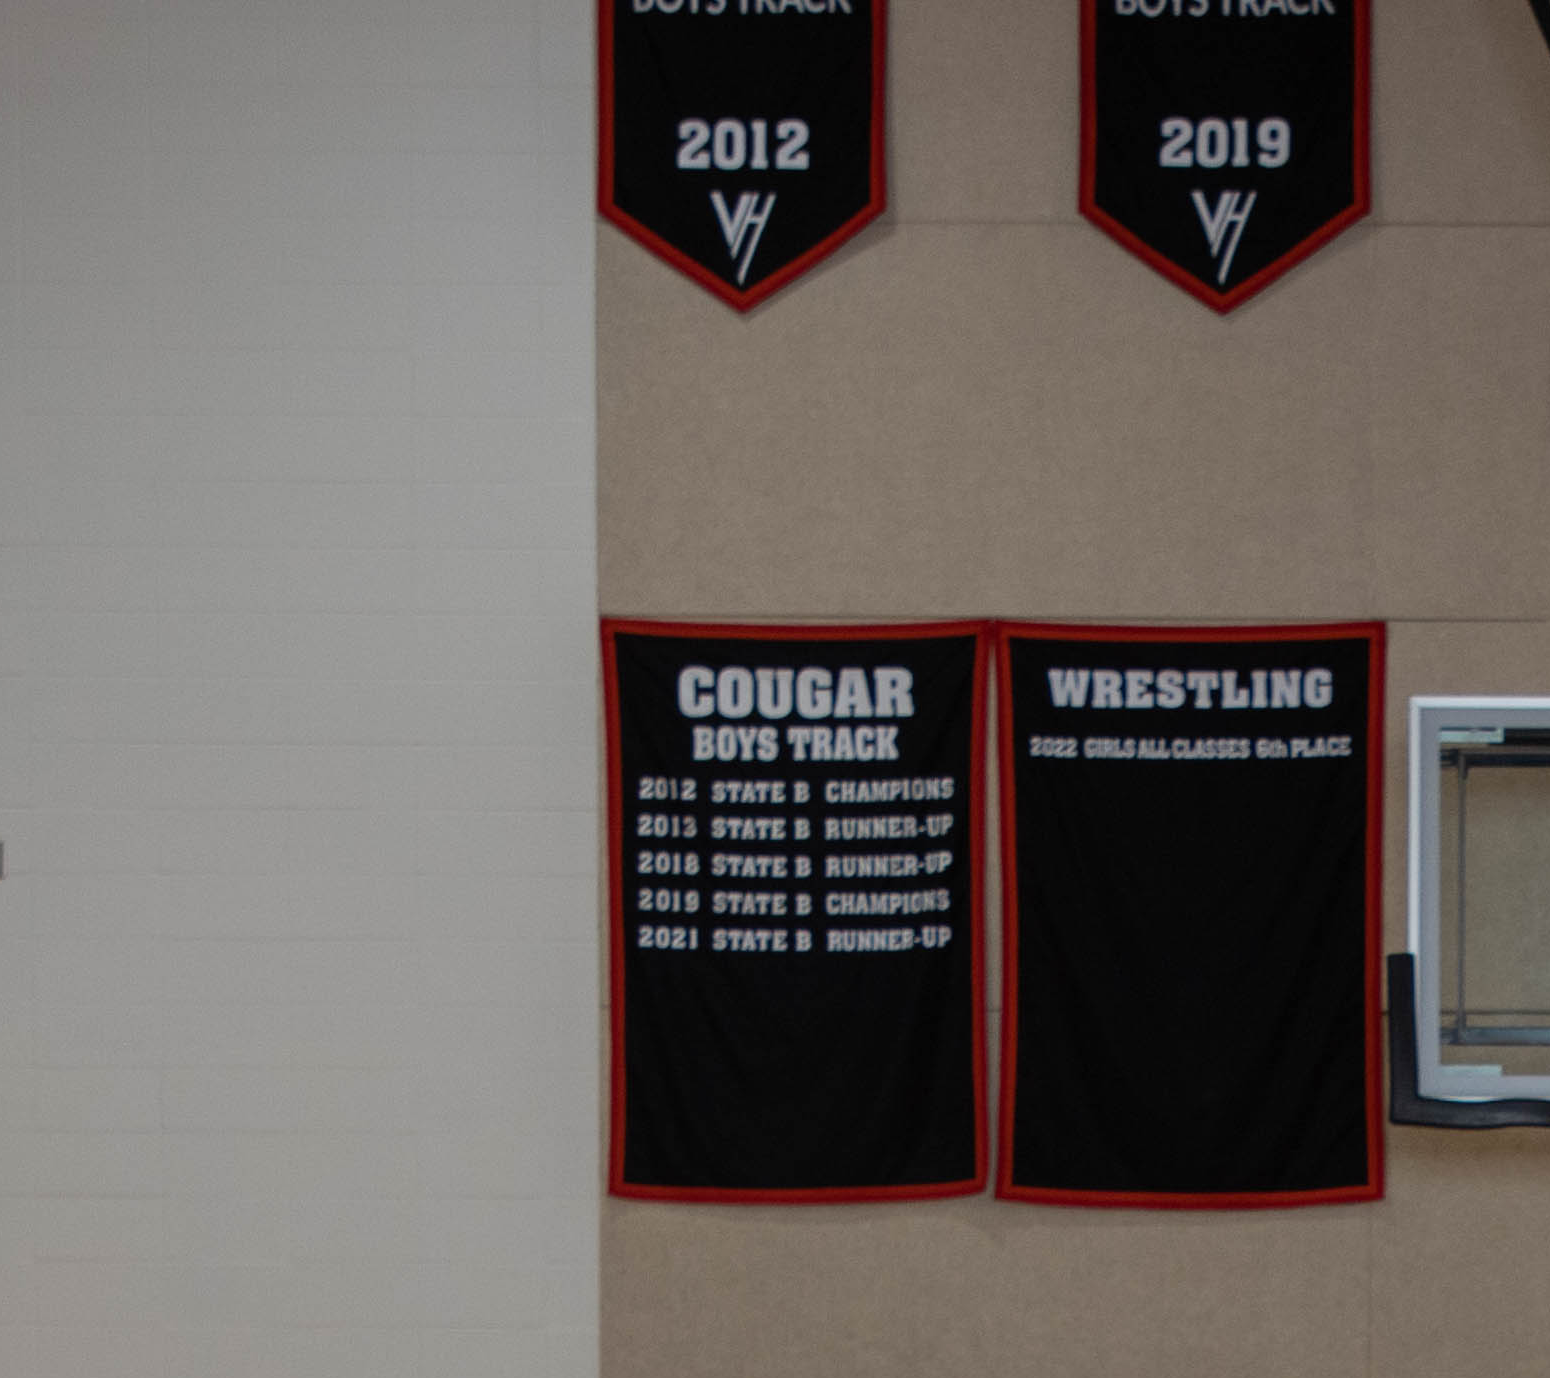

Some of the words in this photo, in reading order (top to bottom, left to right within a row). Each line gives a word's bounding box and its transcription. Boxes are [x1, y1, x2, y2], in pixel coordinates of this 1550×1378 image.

[675, 120, 810, 170] 2012
[1158, 118, 1292, 169] 2019
[678, 666, 914, 719] COUGAR
[1048, 668, 1333, 709] WRESTLING
[692, 726, 779, 761] BOYS
[787, 726, 899, 761] TRACK
[1084, 738, 1136, 759] GIRLS
[1137, 739, 1171, 759] ALL
[1290, 736, 1352, 758] PLACE
[639, 777, 696, 800] 2012
[711, 781, 786, 803] STATE
[794, 781, 809, 803] B
[825, 778, 954, 802] CHAMPIONS
[638, 814, 696, 838] 2013
[711, 818, 787, 840] STATE
[794, 818, 809, 840] B
[824, 814, 953, 840] RUNNER-UP
[638, 851, 699, 874] 2018
[711, 855, 787, 878] STATE
[794, 856, 811, 878] B
[825, 852, 953, 878] RUNNER-UP
[638, 889, 699, 912] 2019
[712, 892, 787, 916] STATE
[796, 892, 811, 915] B
[826, 889, 949, 916] CHAMPIONS
[638, 925, 698, 949] 2021
[712, 929, 788, 952] STATE
[796, 929, 811, 952] B
[826, 926, 952, 952] RUNNER-UP
